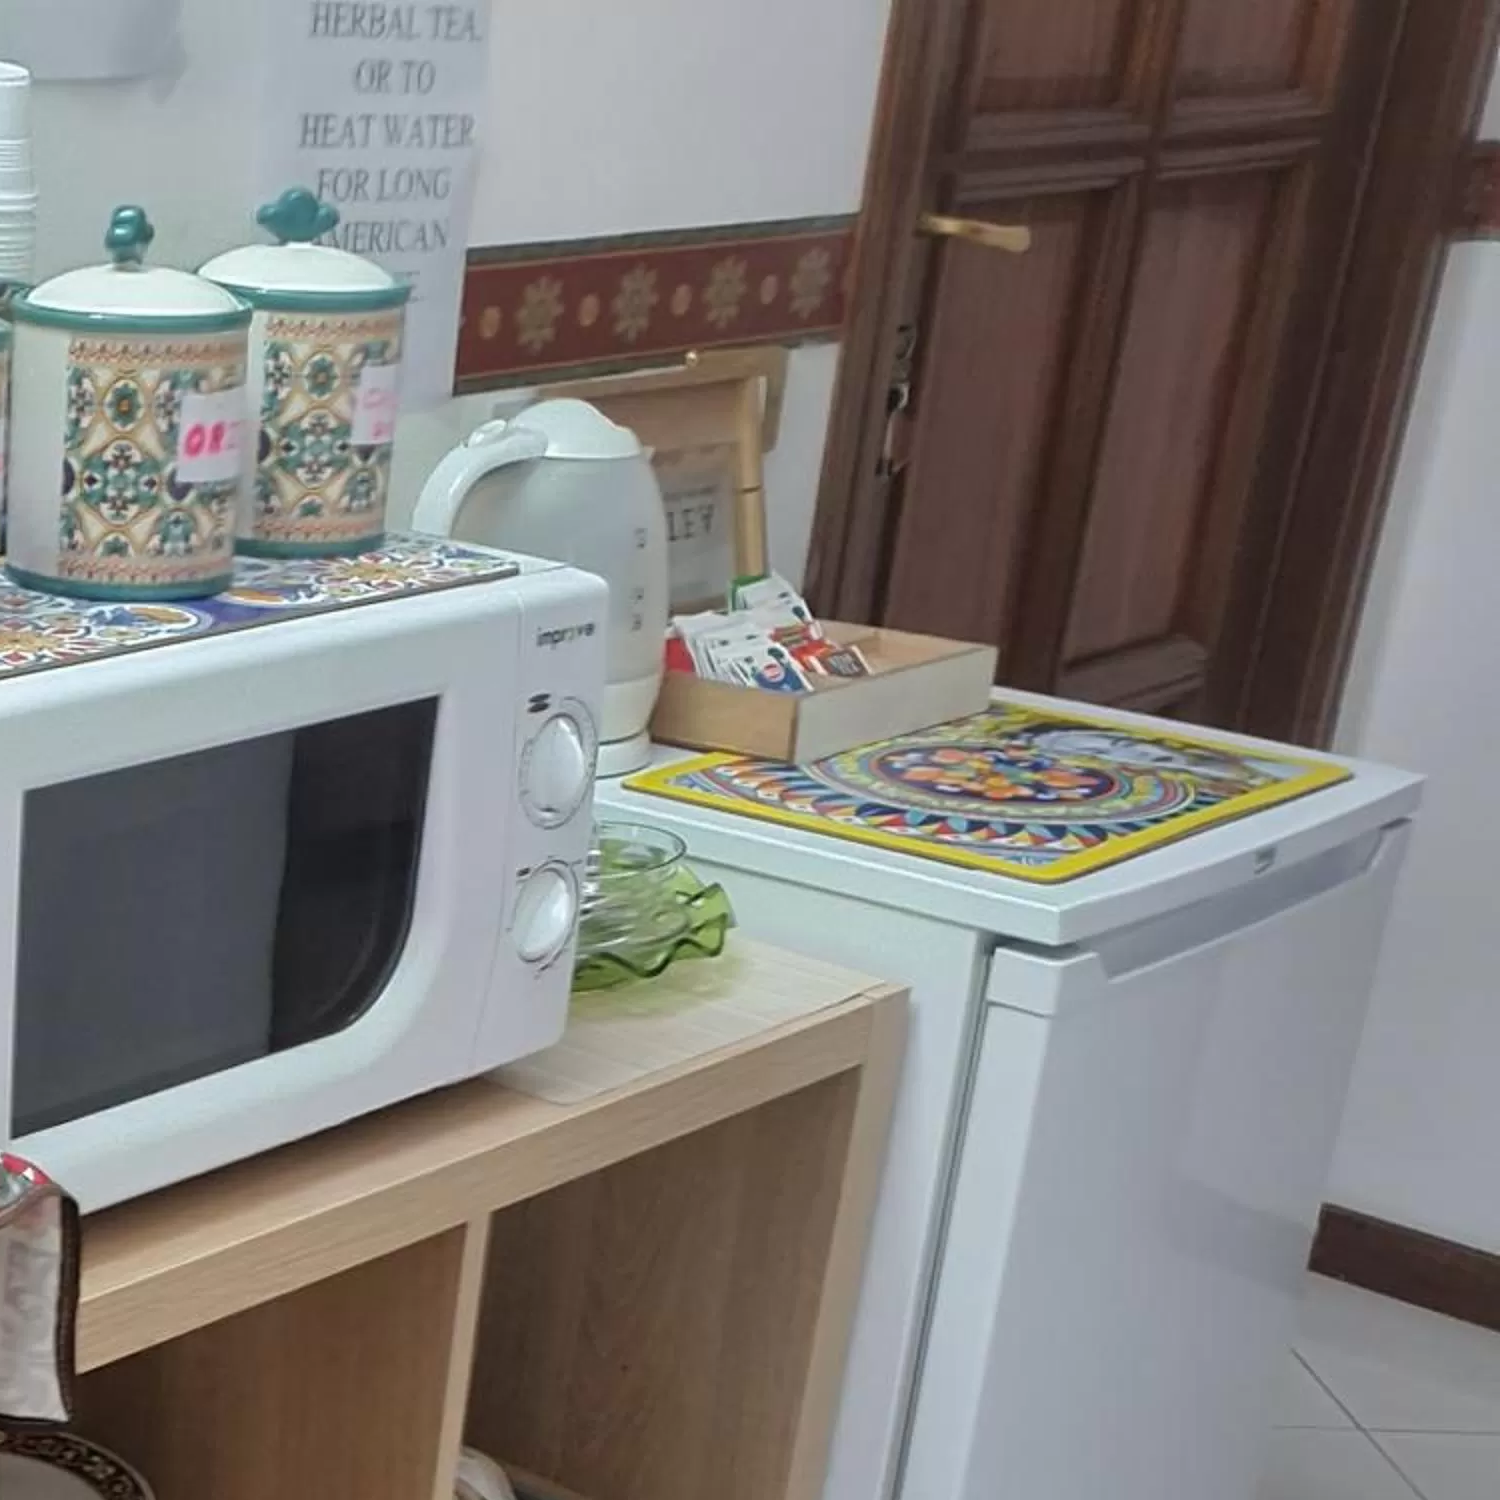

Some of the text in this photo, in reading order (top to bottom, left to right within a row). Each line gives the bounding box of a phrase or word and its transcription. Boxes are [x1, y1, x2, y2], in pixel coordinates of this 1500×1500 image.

[307, 1, 422, 41] HERBAL
[354, 58, 436, 95] OR TO
[298, 112, 476, 149] HEAT WATER
[316, 166, 452, 203] FOR LONG
